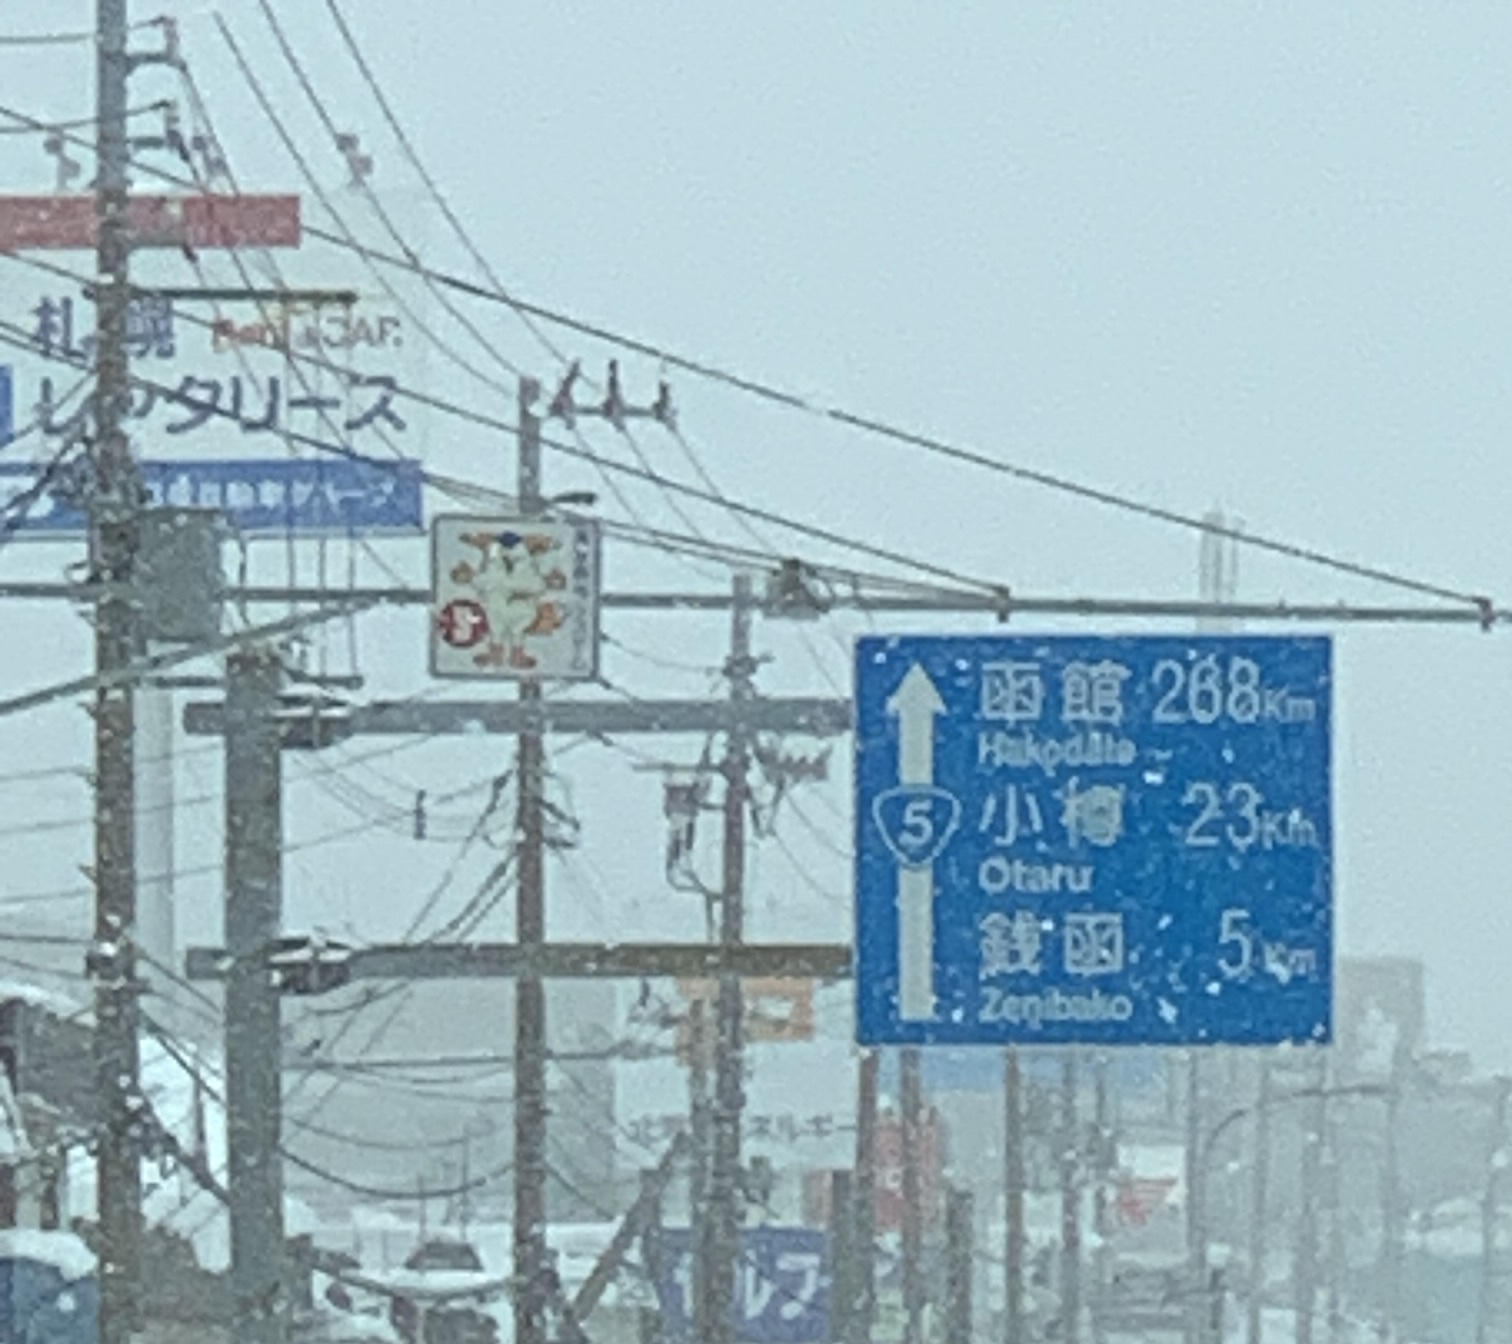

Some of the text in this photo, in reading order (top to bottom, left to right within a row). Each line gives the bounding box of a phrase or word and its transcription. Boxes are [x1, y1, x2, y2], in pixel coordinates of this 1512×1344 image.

[980, 661, 1133, 725] 函館
[903, 800, 935, 846] 5
[978, 777, 1126, 848] 小樽
[978, 856, 1094, 893] Otaru
